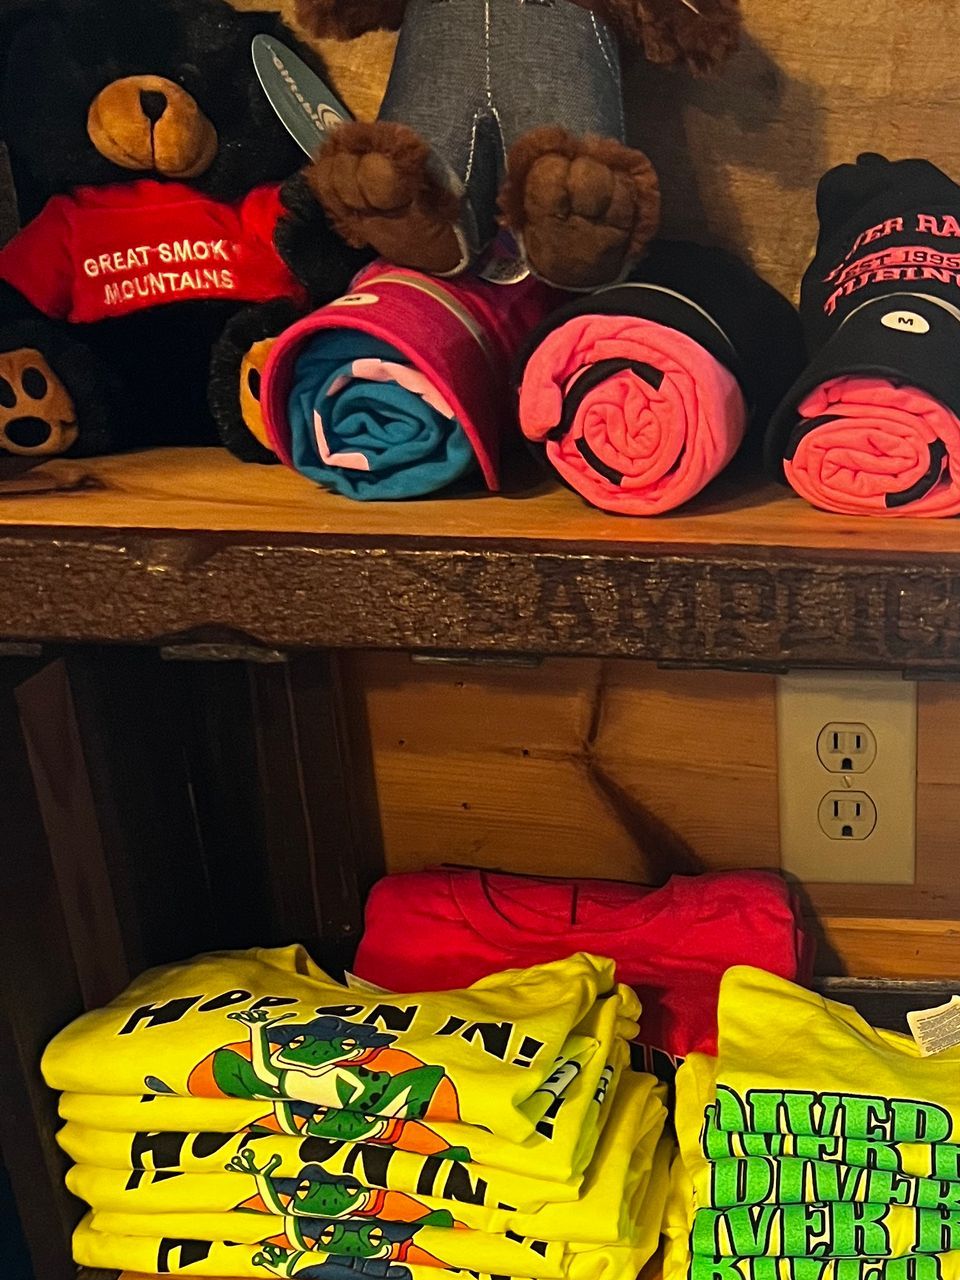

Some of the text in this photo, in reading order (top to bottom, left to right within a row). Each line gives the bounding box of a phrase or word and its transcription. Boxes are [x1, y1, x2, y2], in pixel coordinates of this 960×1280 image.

[83, 239, 232, 278] GREAT SMOK
[103, 269, 235, 305] MOUNTAINS
[897, 316, 915, 327] M
[117, 989, 546, 1069] HOP ON IN!
